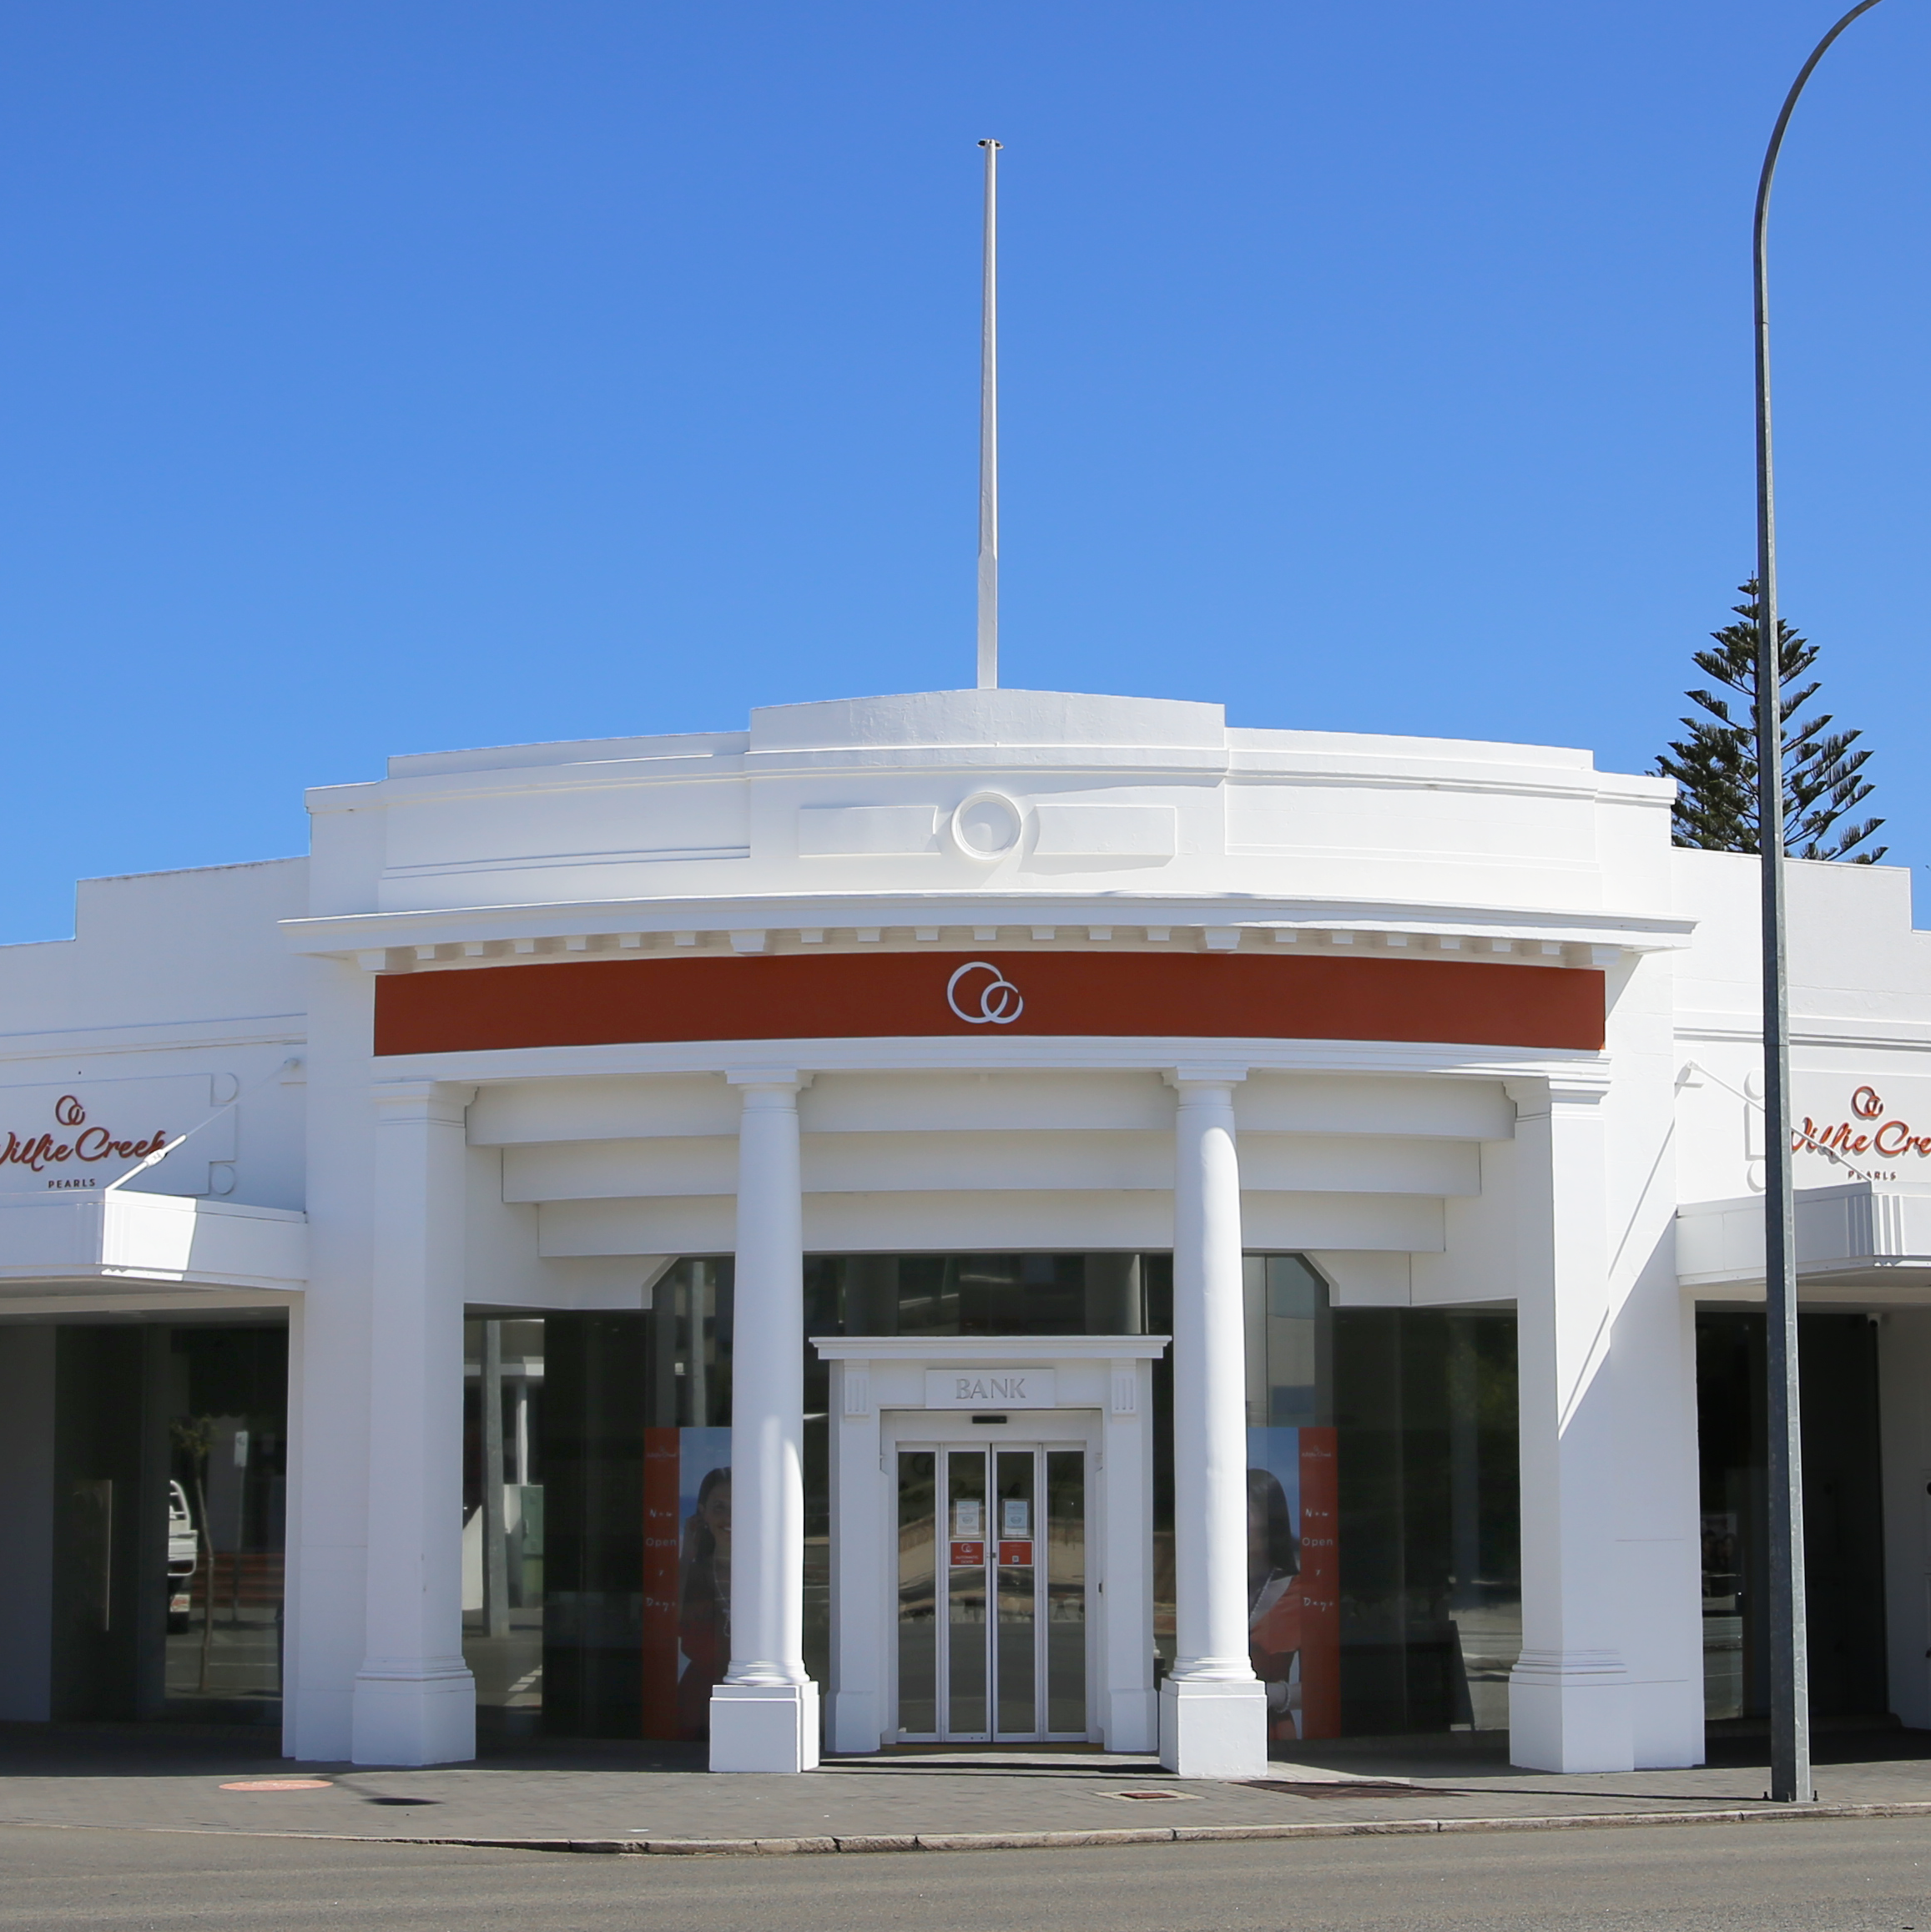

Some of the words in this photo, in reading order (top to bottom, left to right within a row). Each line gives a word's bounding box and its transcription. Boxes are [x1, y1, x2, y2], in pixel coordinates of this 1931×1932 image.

[48, 1178, 95, 1188] PEARLS
[955, 1378, 1026, 1400] BANK
[646, 1537, 677, 1548] Open
[1302, 1537, 1334, 1548] Open
